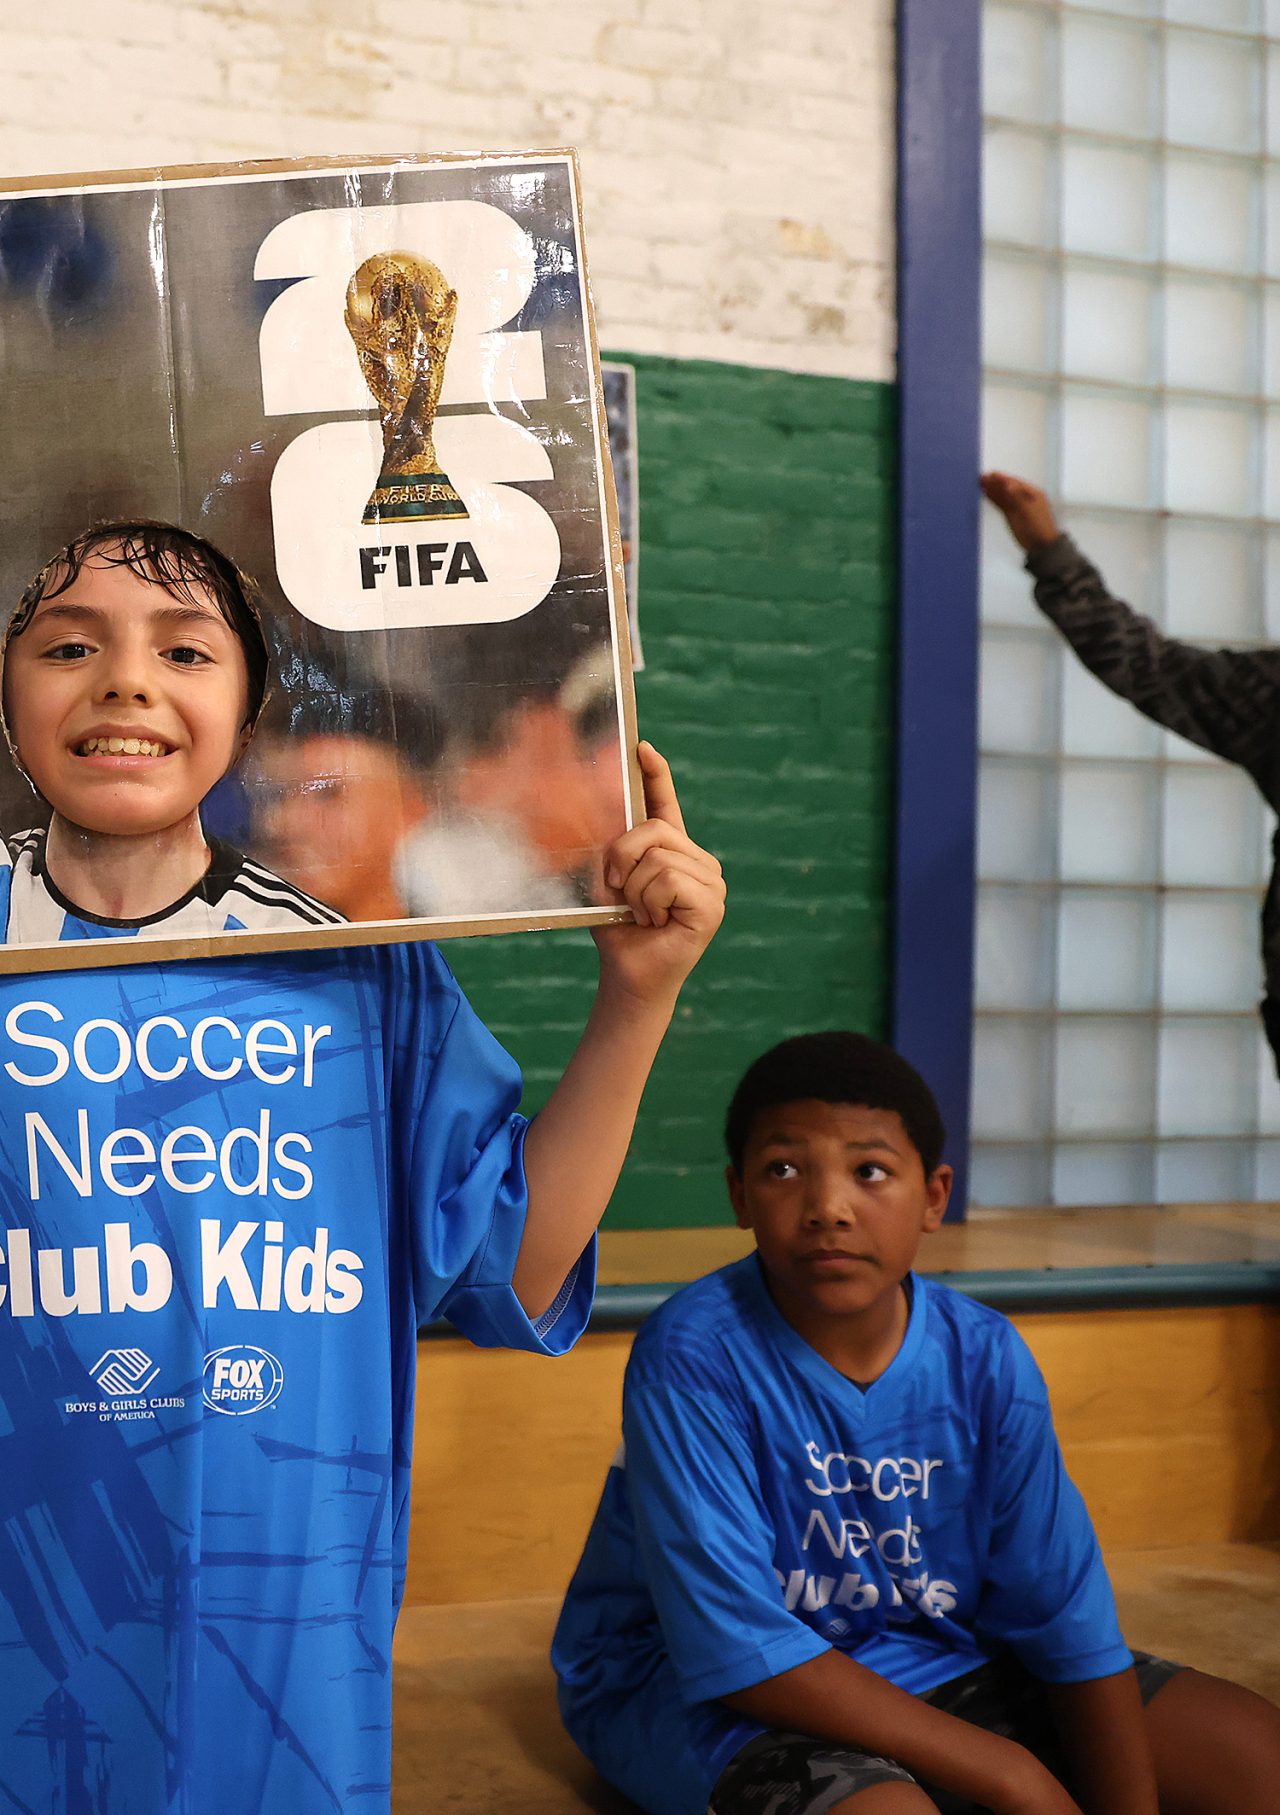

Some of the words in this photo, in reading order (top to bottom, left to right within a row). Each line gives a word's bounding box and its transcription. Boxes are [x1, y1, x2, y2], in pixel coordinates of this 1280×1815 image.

[390, 484, 443, 494] FIFA
[359, 541, 488, 590] FIFA
[3, 1000, 332, 1088] Soccer
[24, 1108, 314, 1200] Needs
[200, 1218, 365, 1315] Kids
[213, 1358, 267, 1389] FOX
[65, 1401, 97, 1413] BOYS
[99, 1401, 109, 1411] &
[111, 1399, 148, 1412] GIRLS
[150, 1397, 185, 1409] CLUBS
[211, 1388, 265, 1401] SPORTS
[99, 1413, 113, 1422] OF
[114, 1411, 155, 1421] AMERICA
